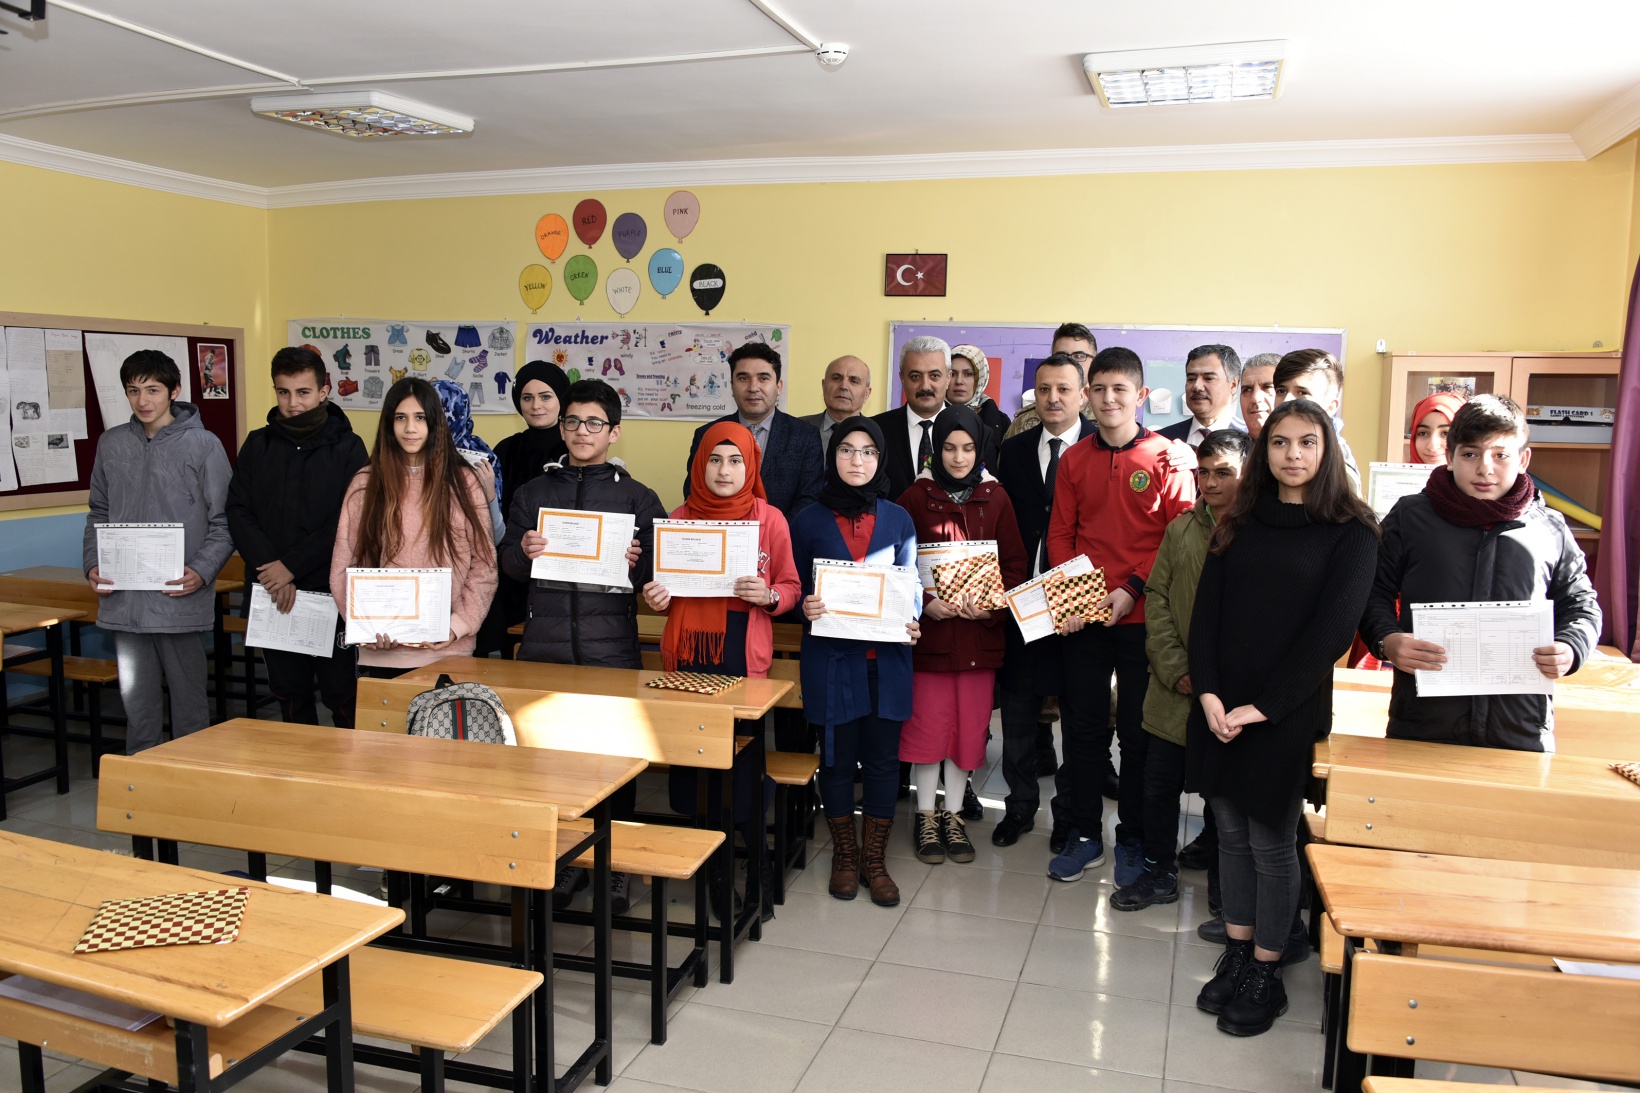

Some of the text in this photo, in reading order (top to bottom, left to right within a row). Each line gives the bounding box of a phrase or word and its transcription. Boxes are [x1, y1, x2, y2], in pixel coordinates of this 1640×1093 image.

[582, 216, 596, 225] RED
[541, 230, 561, 240] ORANGE
[618, 230, 641, 238] PURPLE
[657, 266, 672, 274] BLUE
[570, 272, 589, 281] GREEN
[524, 282, 547, 291] YELLOW
[612, 286, 632, 294] WHITE
[301, 326, 371, 339] CLOTHES
[532, 327, 609, 345] Weather
[744, 331, 758, 340] cold
[686, 403, 711, 411] freezing
